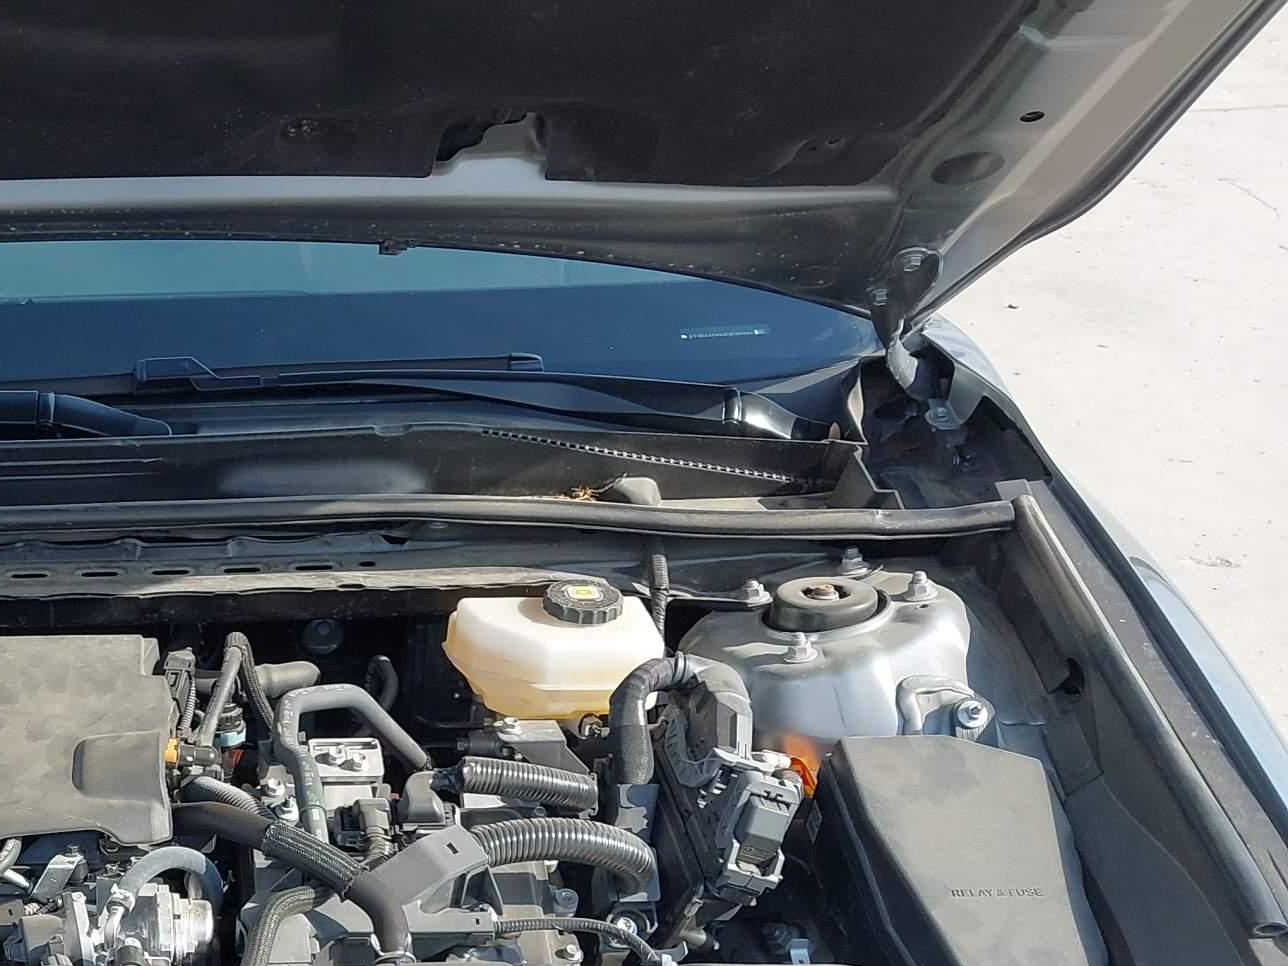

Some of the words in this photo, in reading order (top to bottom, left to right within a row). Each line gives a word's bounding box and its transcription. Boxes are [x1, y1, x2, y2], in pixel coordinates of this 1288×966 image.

[951, 887, 993, 898] RELAY
[996, 888, 1006, 897] &
[1008, 887, 1045, 897] FUSE
